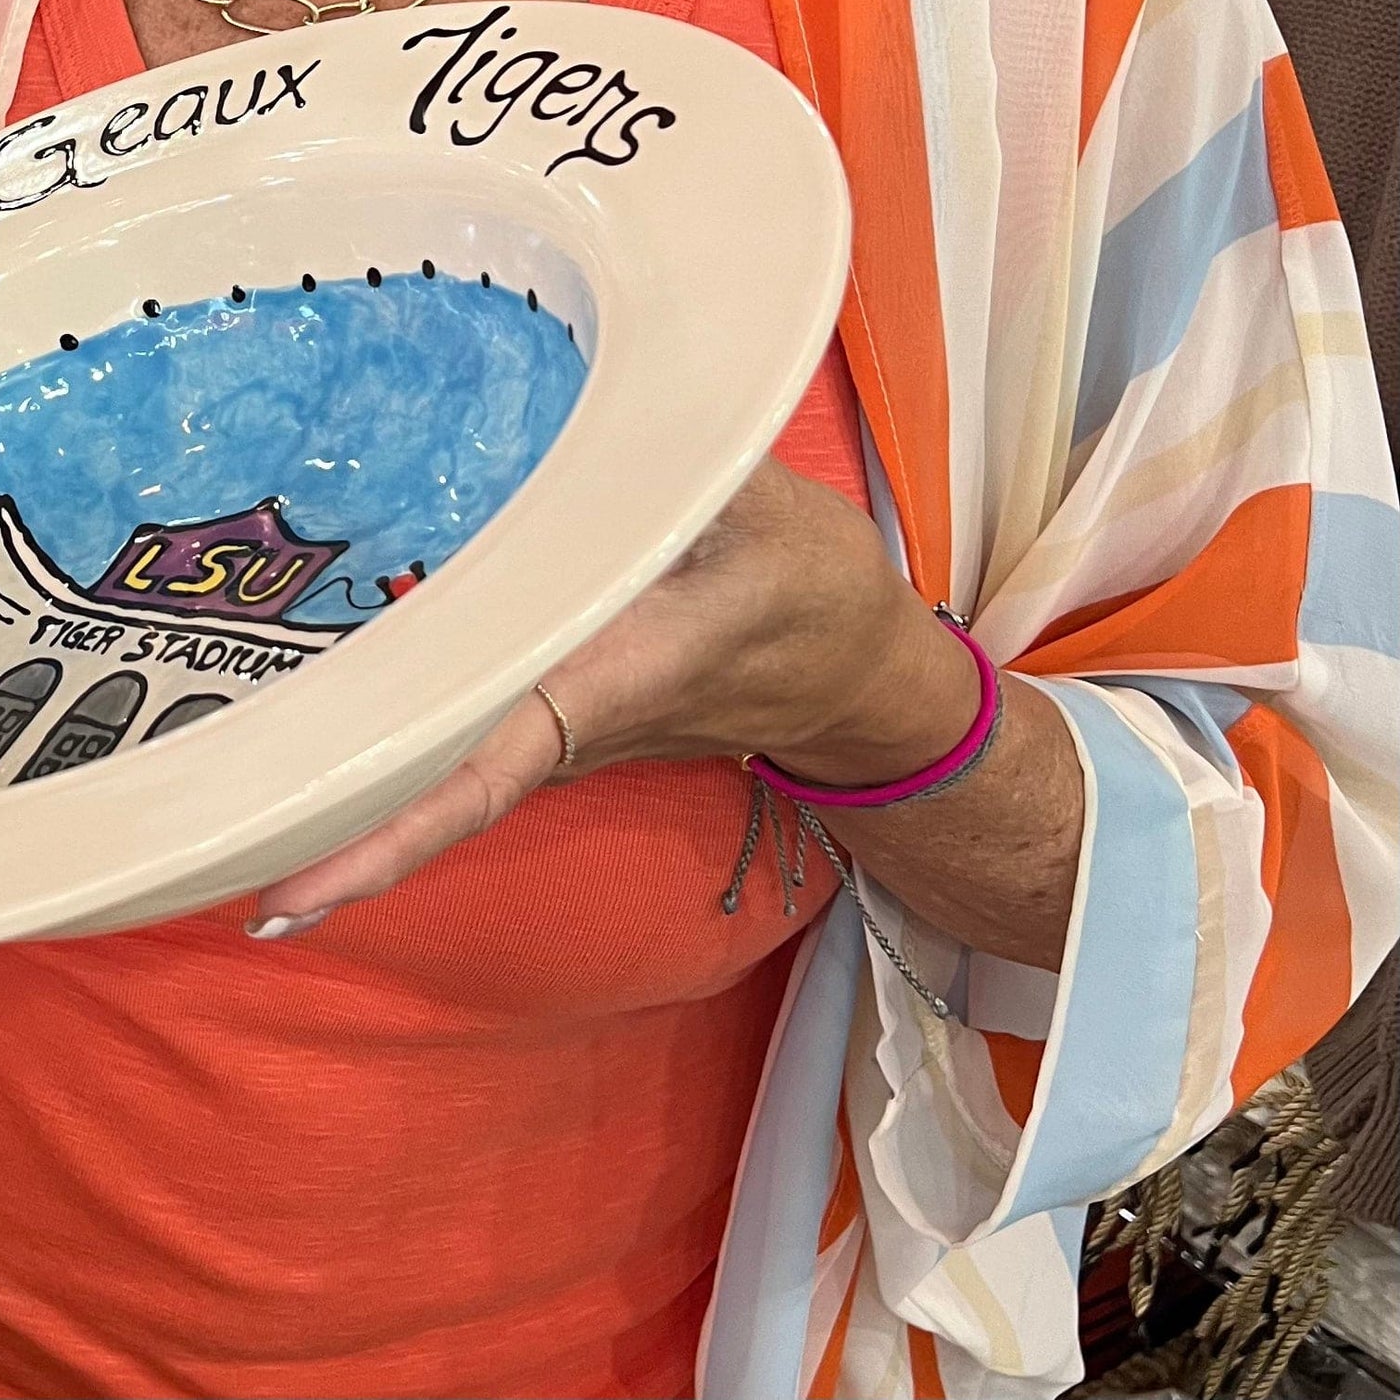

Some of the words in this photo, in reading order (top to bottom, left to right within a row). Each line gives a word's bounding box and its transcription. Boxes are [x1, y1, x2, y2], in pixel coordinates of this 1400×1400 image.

[402, 4, 677, 178] Tigers
[112, 535, 315, 607] LSU
[29, 614, 125, 656] TIGER
[120, 626, 304, 685] STADIUM
